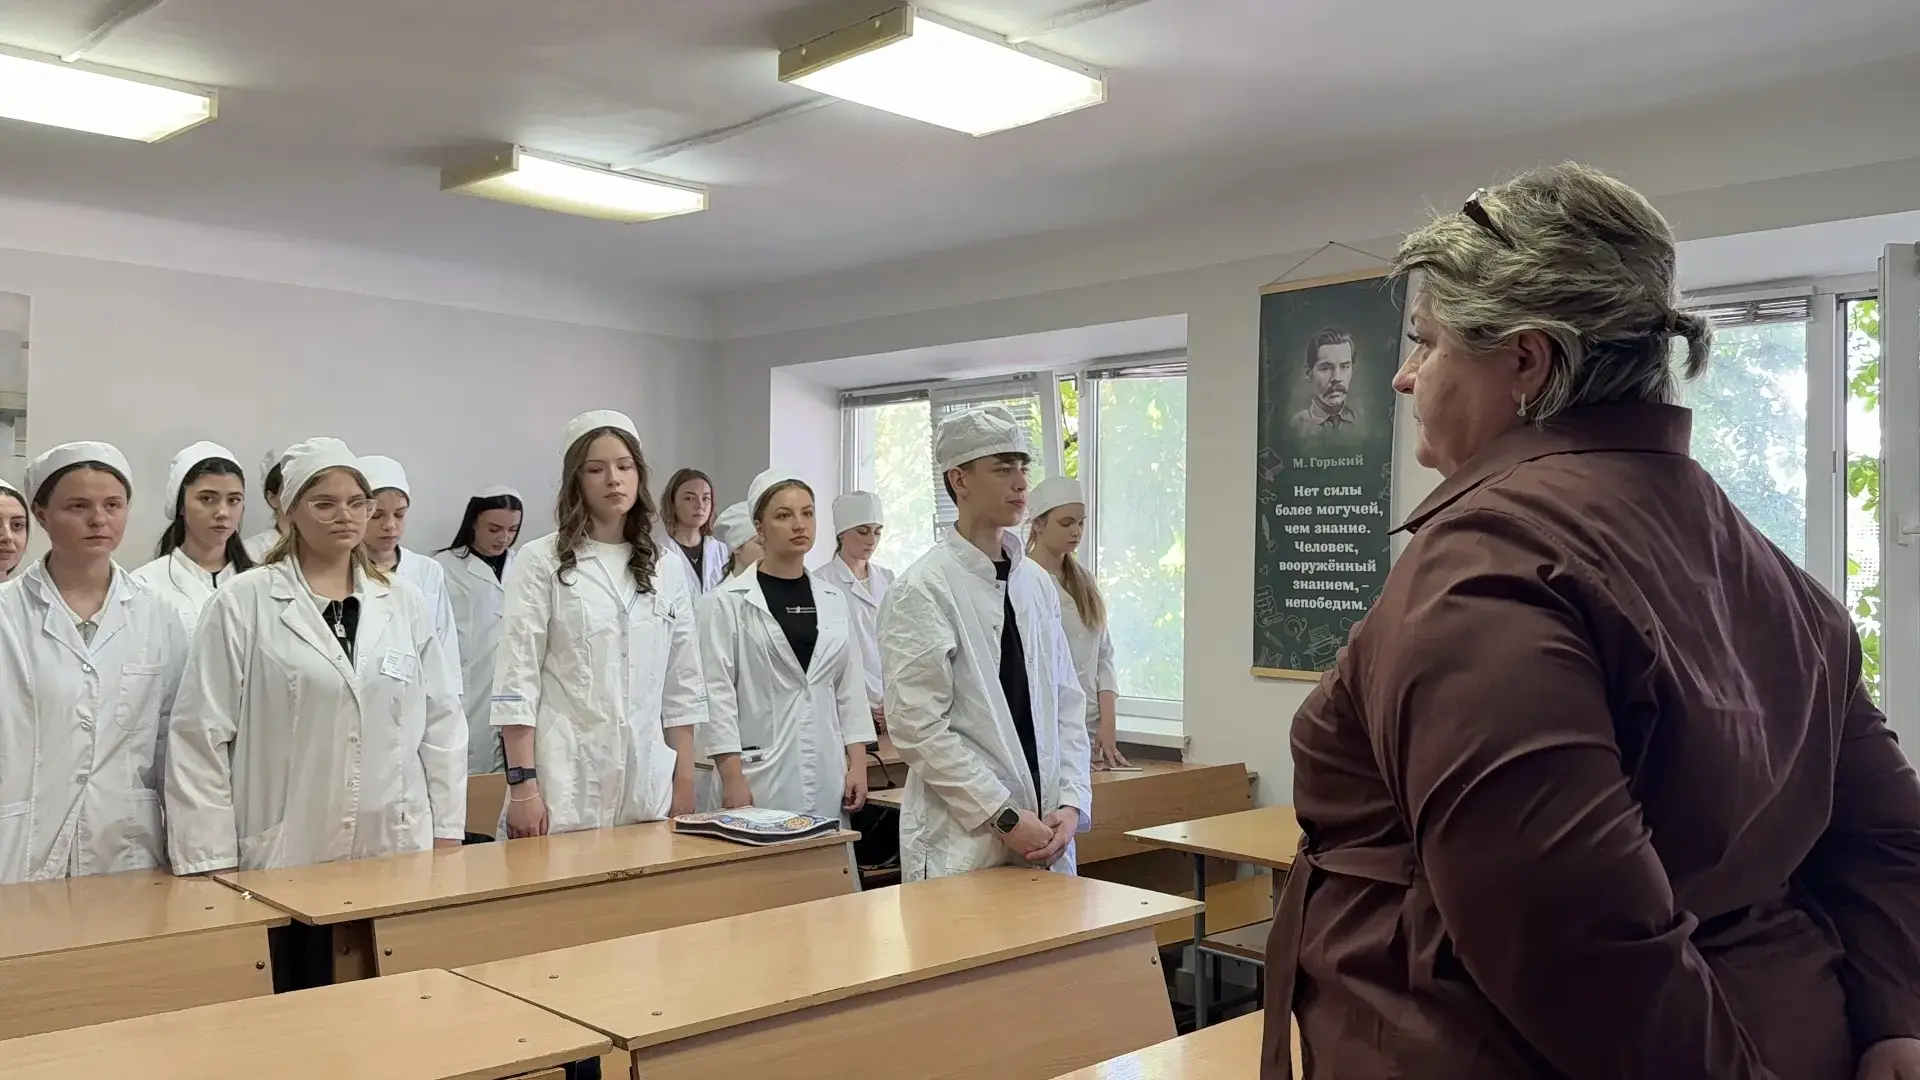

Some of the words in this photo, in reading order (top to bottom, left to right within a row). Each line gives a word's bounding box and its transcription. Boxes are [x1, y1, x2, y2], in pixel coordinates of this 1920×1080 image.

[1292, 457, 1307, 469] М.
[1309, 454, 1364, 469] Горький
[1293, 485, 1320, 497] Нет
[1323, 485, 1363, 497] силы
[1275, 503, 1313, 516] более
[1316, 502, 1384, 517] могучей,
[1284, 524, 1310, 535] чем
[1314, 523, 1371, 535] знание.
[1294, 541, 1359, 555] Человек,
[1279, 559, 1377, 574] вооружённый
[1285, 596, 1368, 612] непобедим.
